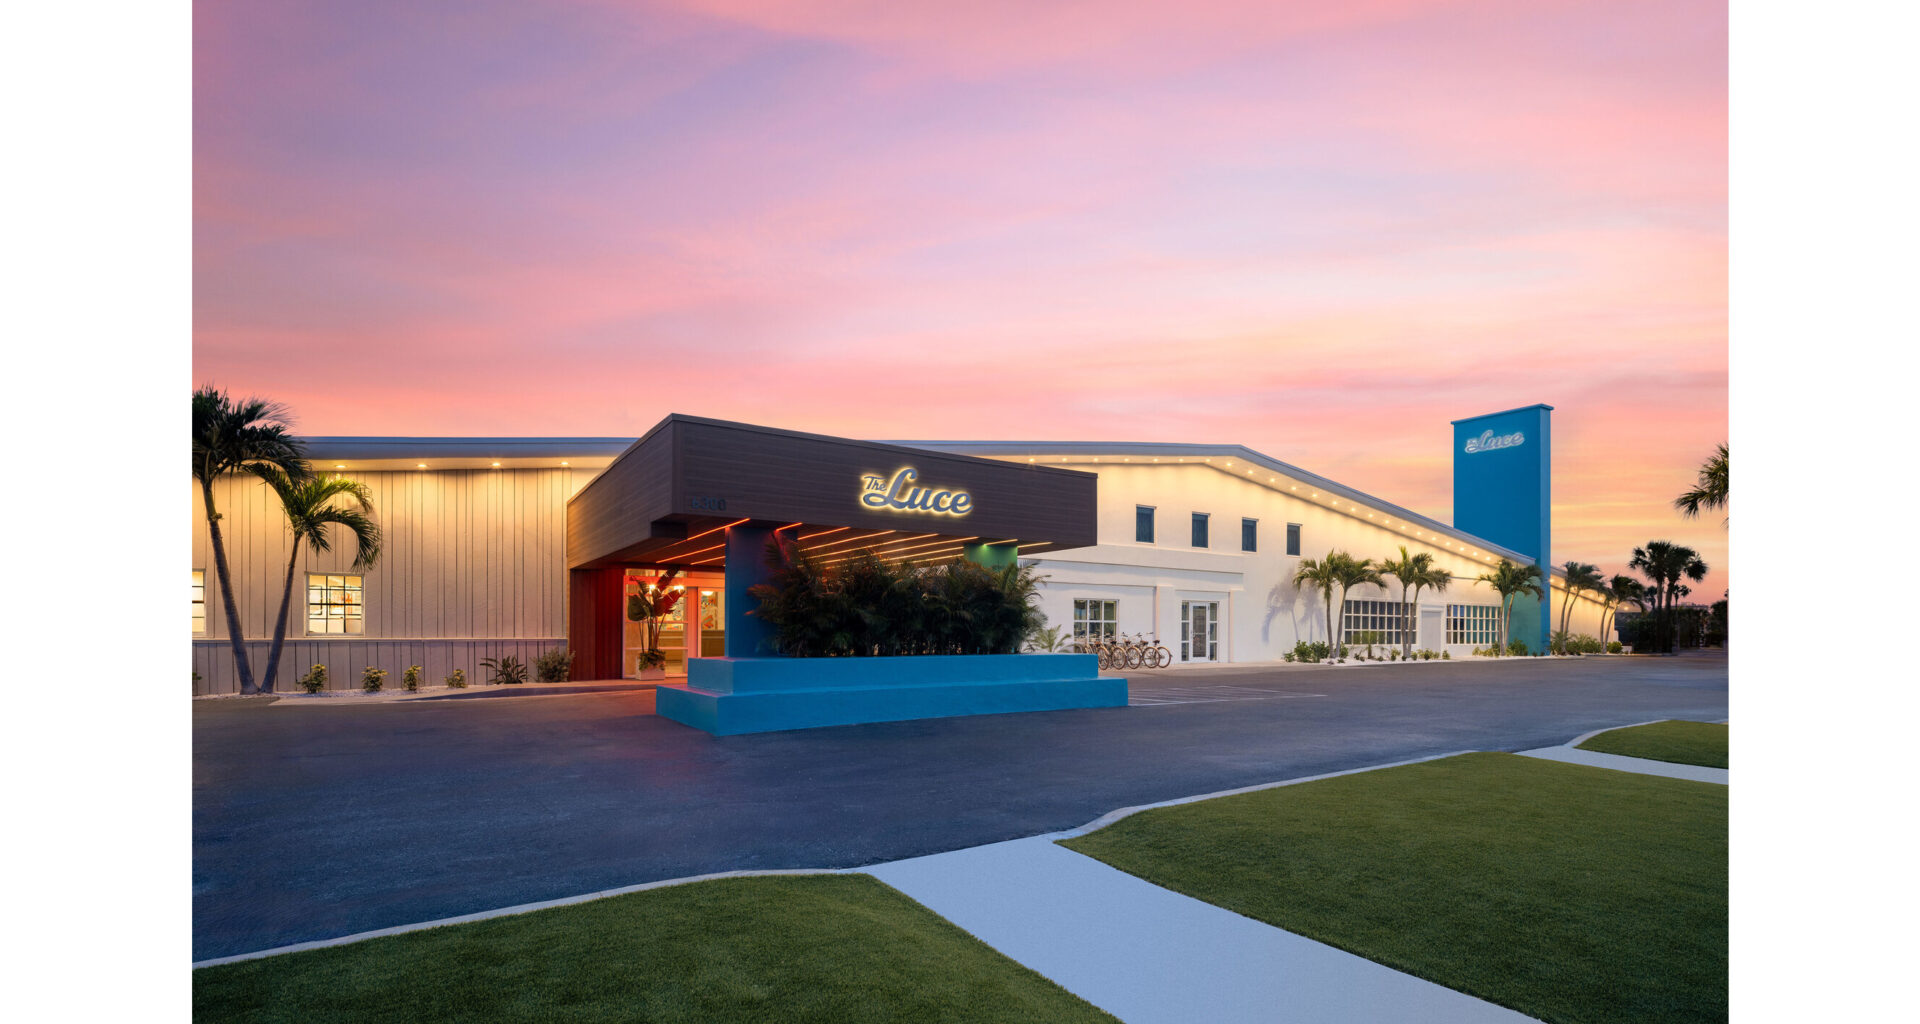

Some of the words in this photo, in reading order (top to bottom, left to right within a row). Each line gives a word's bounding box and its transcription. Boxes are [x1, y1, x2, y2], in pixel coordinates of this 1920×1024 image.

[1464, 429, 1525, 453] Luce
[862, 468, 975, 514] Luce
[863, 475, 887, 491] The
